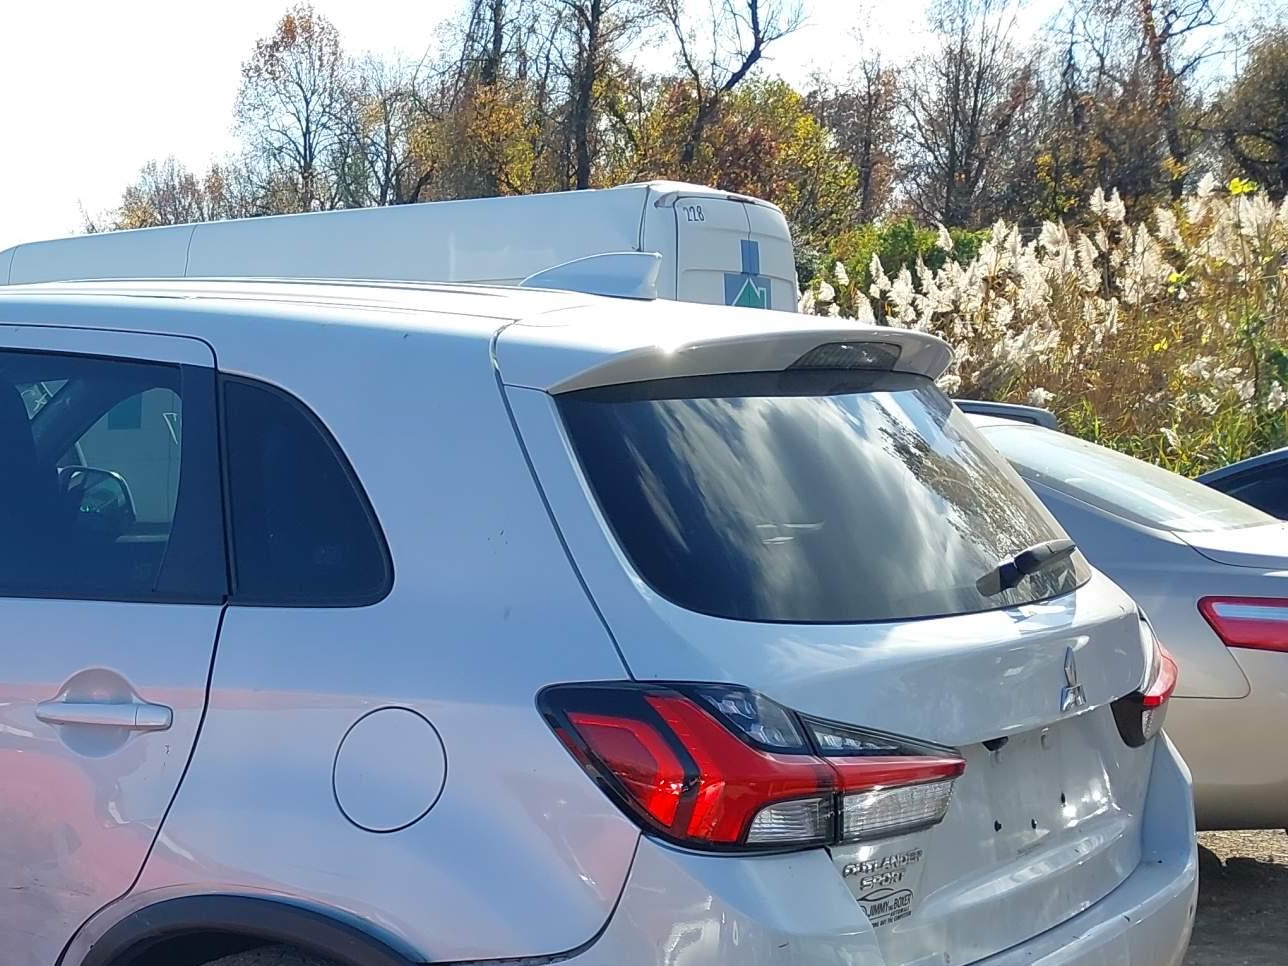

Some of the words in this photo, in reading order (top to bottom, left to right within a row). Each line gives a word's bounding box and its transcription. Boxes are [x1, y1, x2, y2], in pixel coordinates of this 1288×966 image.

[682, 205, 705, 222] 228
[842, 847, 923, 878] OUTLANDER
[860, 869, 905, 891] SPORT
